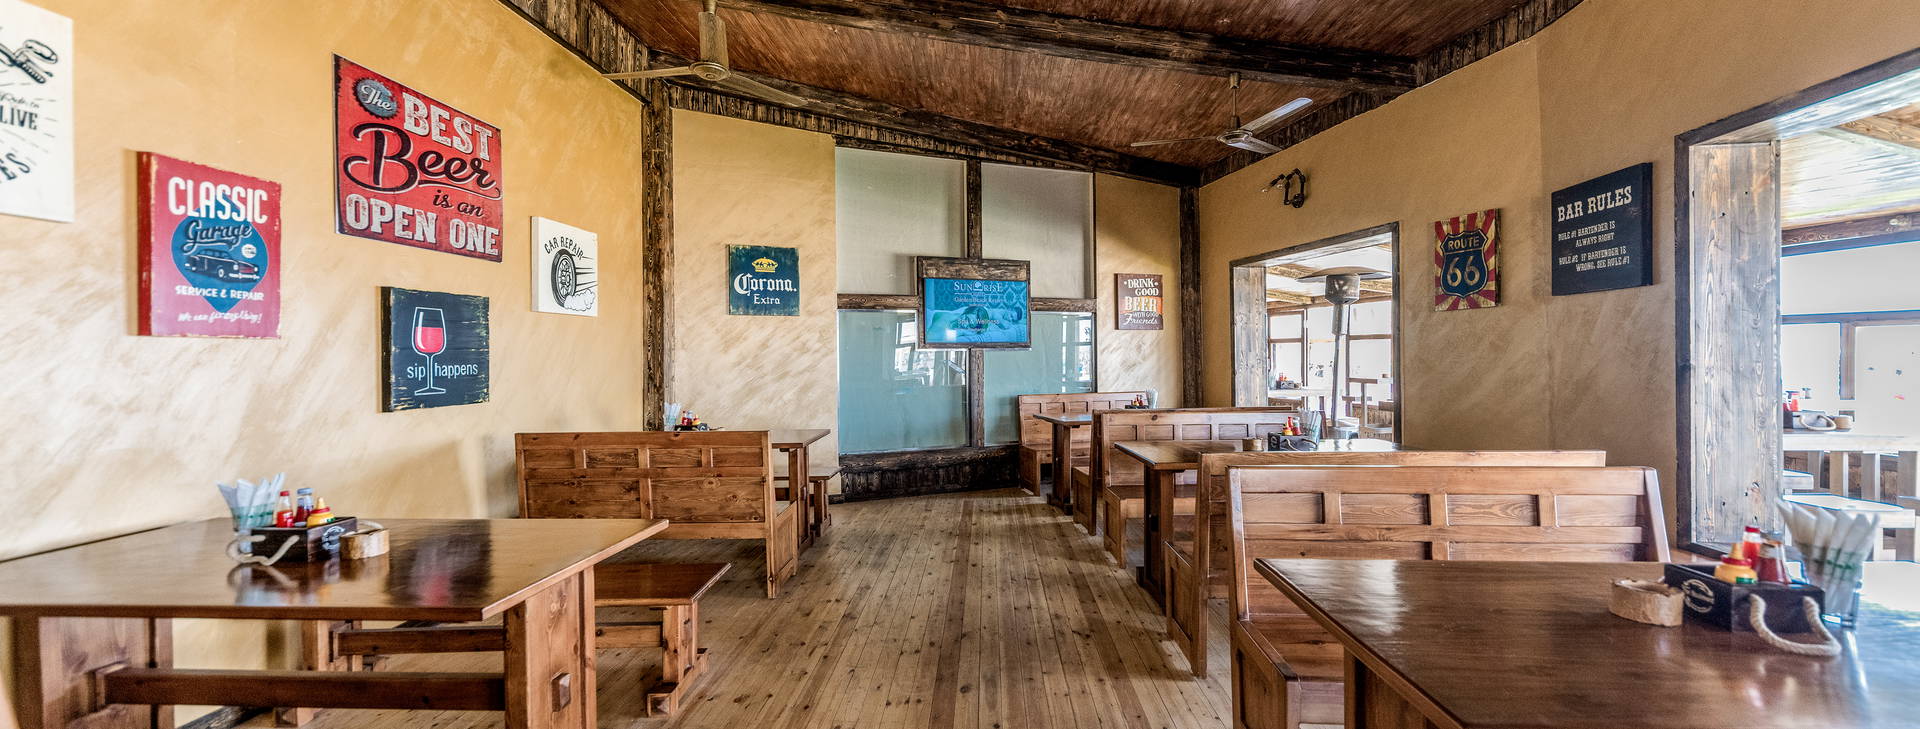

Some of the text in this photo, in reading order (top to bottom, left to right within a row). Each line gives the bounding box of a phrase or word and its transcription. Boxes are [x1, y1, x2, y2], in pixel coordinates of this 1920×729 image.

[361, 84, 392, 111] The
[402, 92, 492, 161] BEST
[343, 122, 502, 200] Beer
[168, 176, 269, 224] CLASSIC
[432, 189, 484, 218] is an
[1557, 186, 1632, 222] BAR RULES
[345, 193, 500, 257] OPEN ONE
[1558, 231, 1571, 241] RULE
[1578, 223, 1608, 236] BARTENDER
[1609, 220, 1616, 230] IS
[182, 219, 253, 256] Garage
[1448, 235, 1481, 251] ROUTE
[1575, 232, 1615, 248] ALWAYS RIGHT
[544, 236, 584, 261] CAR REPAIR
[1559, 256, 1571, 265] RULE
[1588, 248, 1619, 260] BARTENDER
[1620, 246, 1626, 254] IS
[1446, 255, 1481, 287] 66
[1596, 259, 1607, 269] SEE
[1607, 256, 1622, 267] RULE
[175, 285, 264, 301] SERVICE & REPAIR
[1128, 278, 1154, 288] DRINK
[1135, 288, 1159, 296] GOOD
[753, 293, 781, 305] Extra
[1124, 296, 1157, 312] BEER
[407, 362, 479, 381] sip happens
